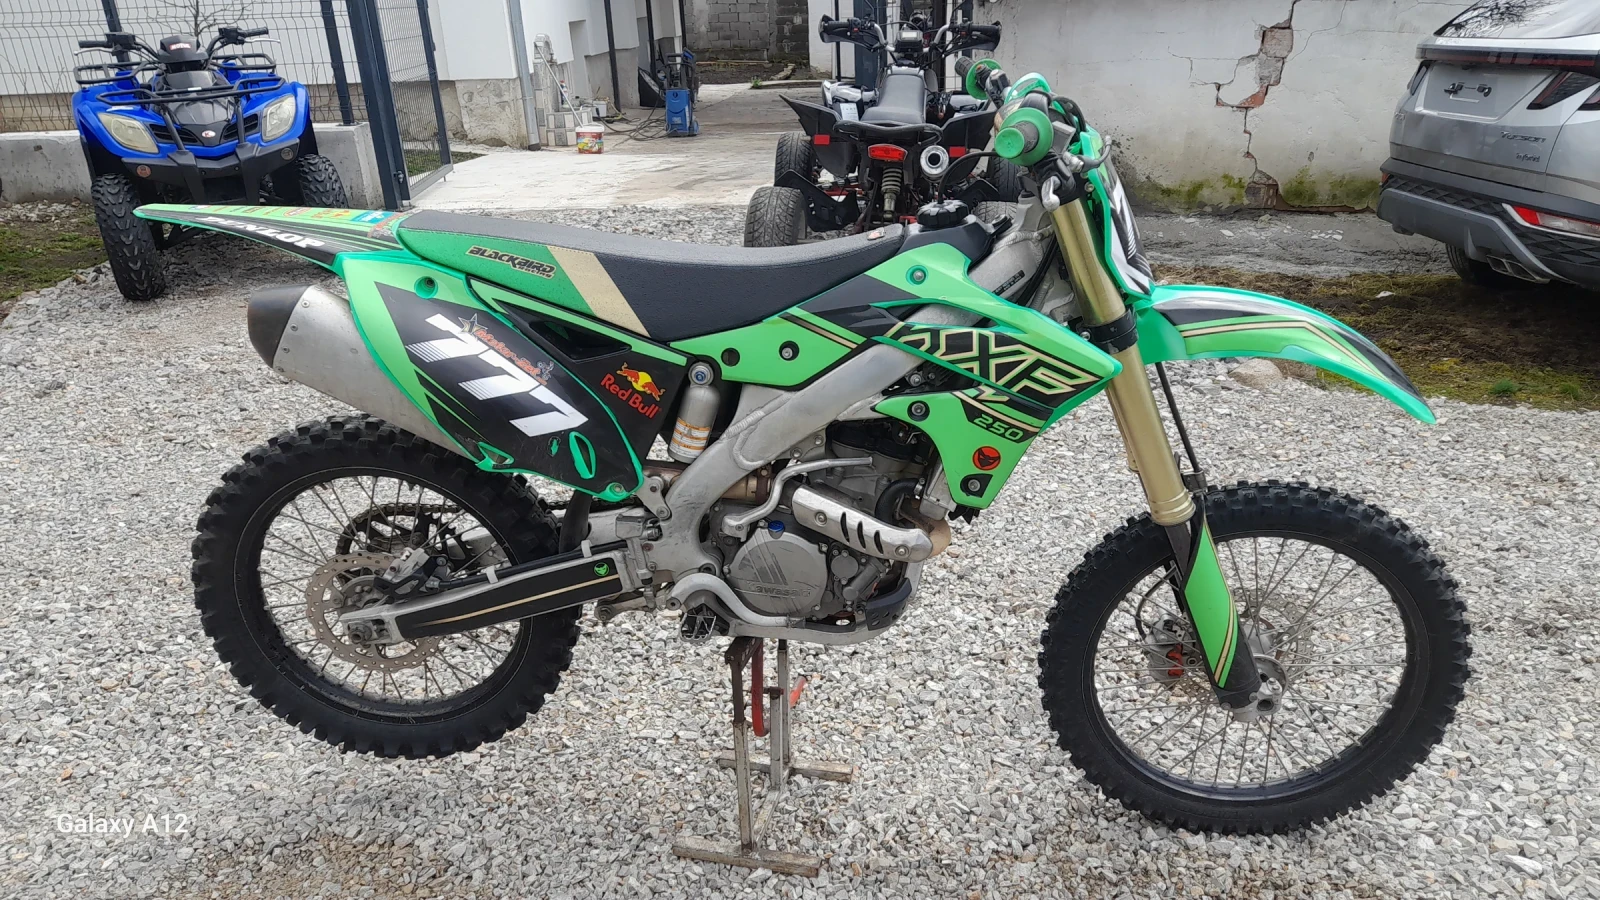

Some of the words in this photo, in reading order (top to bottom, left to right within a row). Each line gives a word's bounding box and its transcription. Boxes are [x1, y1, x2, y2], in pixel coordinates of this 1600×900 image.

[196, 216, 325, 248] DUNLOP
[468, 246, 555, 273] BLACKBIRD
[405, 313, 589, 437] 777
[600, 373, 632, 401] Red
[628, 393, 659, 418] Bull
[973, 413, 1024, 440] 250
